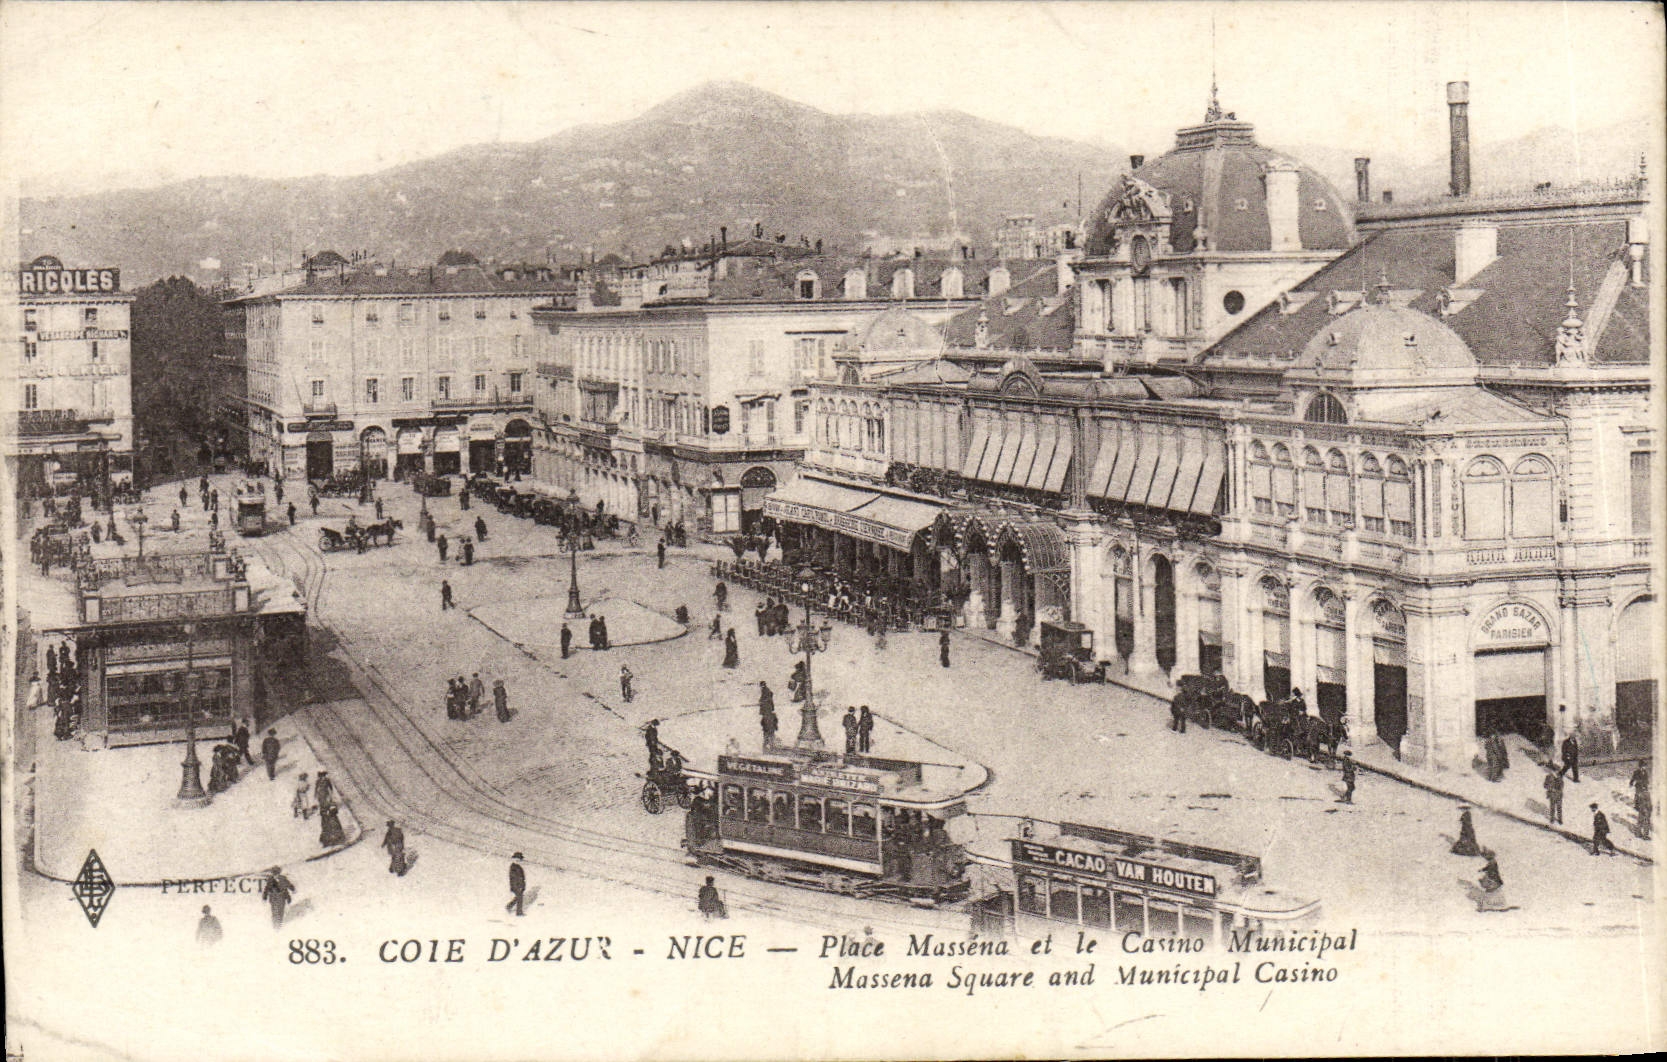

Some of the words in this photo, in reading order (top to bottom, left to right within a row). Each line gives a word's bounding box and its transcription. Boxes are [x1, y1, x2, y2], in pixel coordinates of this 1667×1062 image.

[1481, 607, 1508, 634] GRAND
[1513, 607, 1541, 631] BAZAR
[1490, 628, 1533, 640] PARISIEN
[1055, 850, 1107, 874] CACAO
[1116, 860, 1145, 881] VAN
[1152, 868, 1215, 894] HOUTEN
